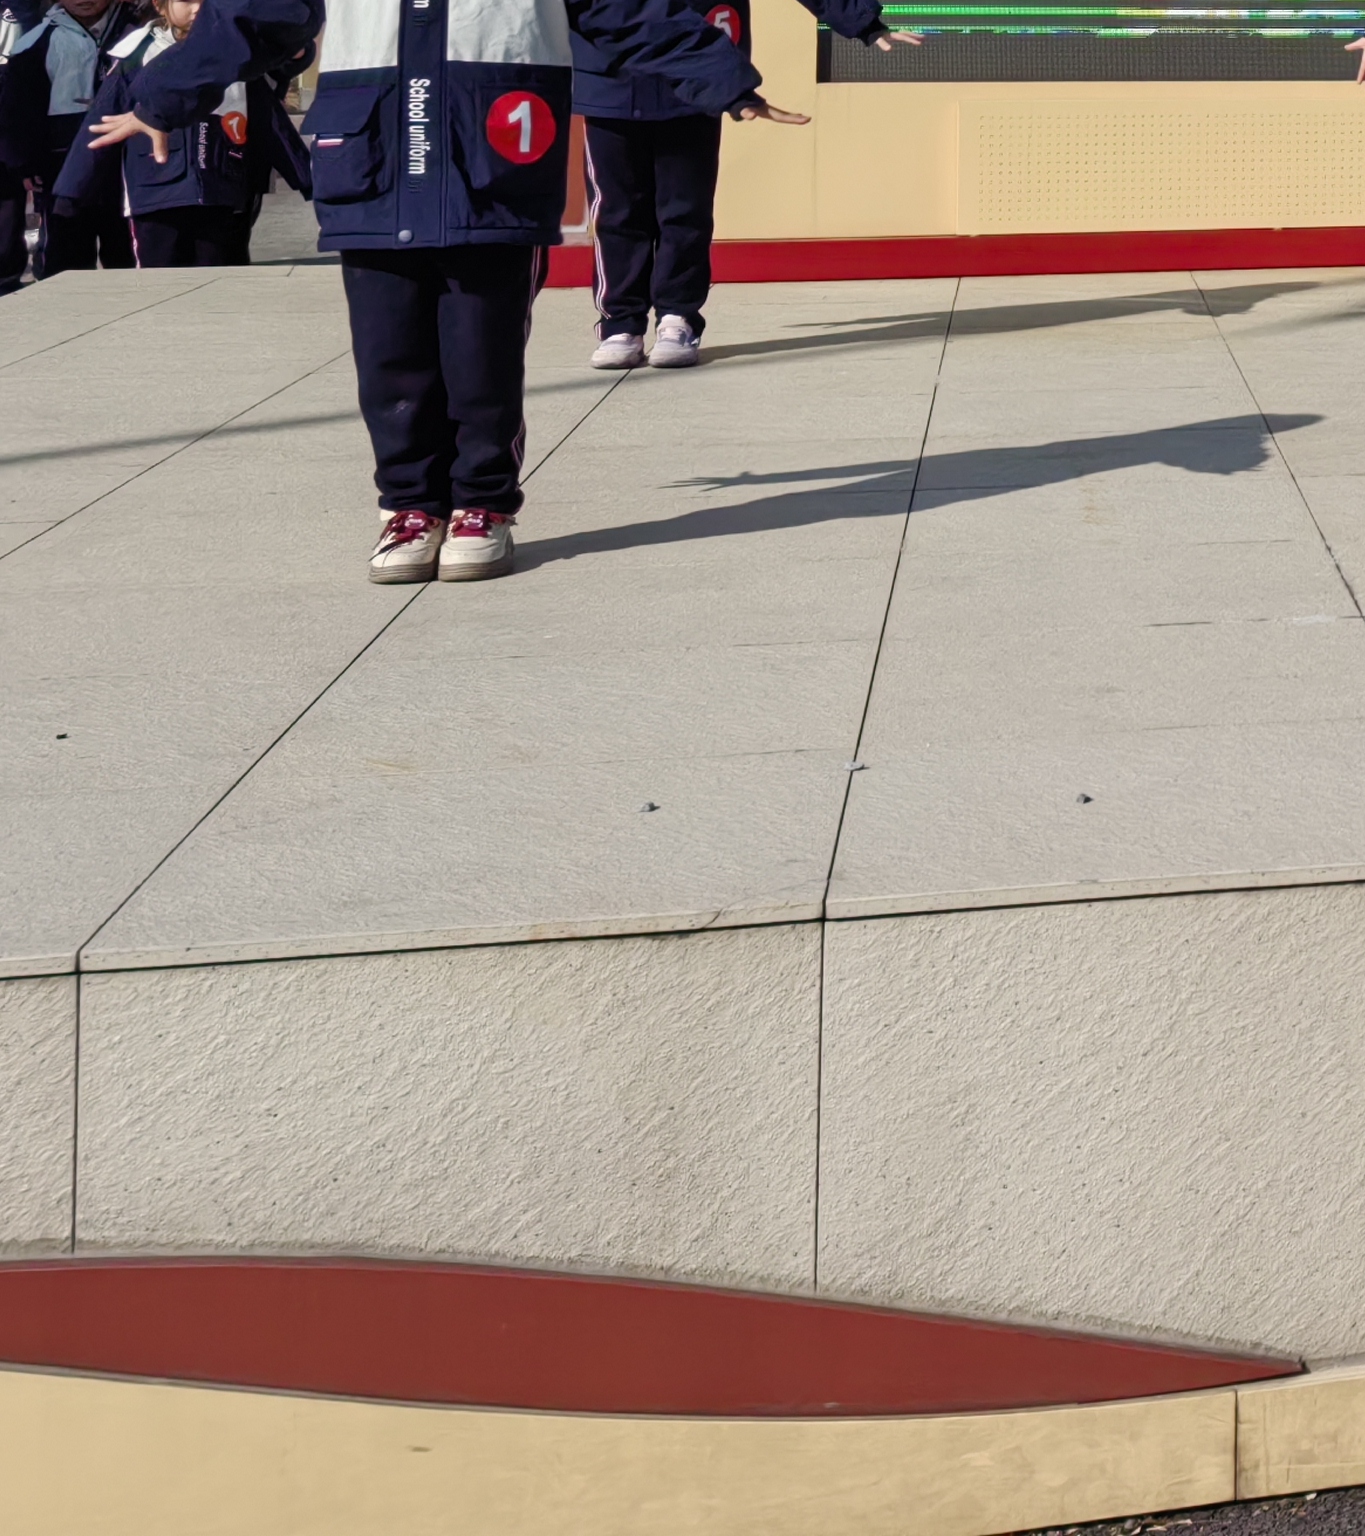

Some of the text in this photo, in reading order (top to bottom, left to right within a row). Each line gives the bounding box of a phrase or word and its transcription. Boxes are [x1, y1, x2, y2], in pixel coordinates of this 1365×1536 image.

[408, 79, 431, 174] School uniform
[508, 100, 532, 154] 1
